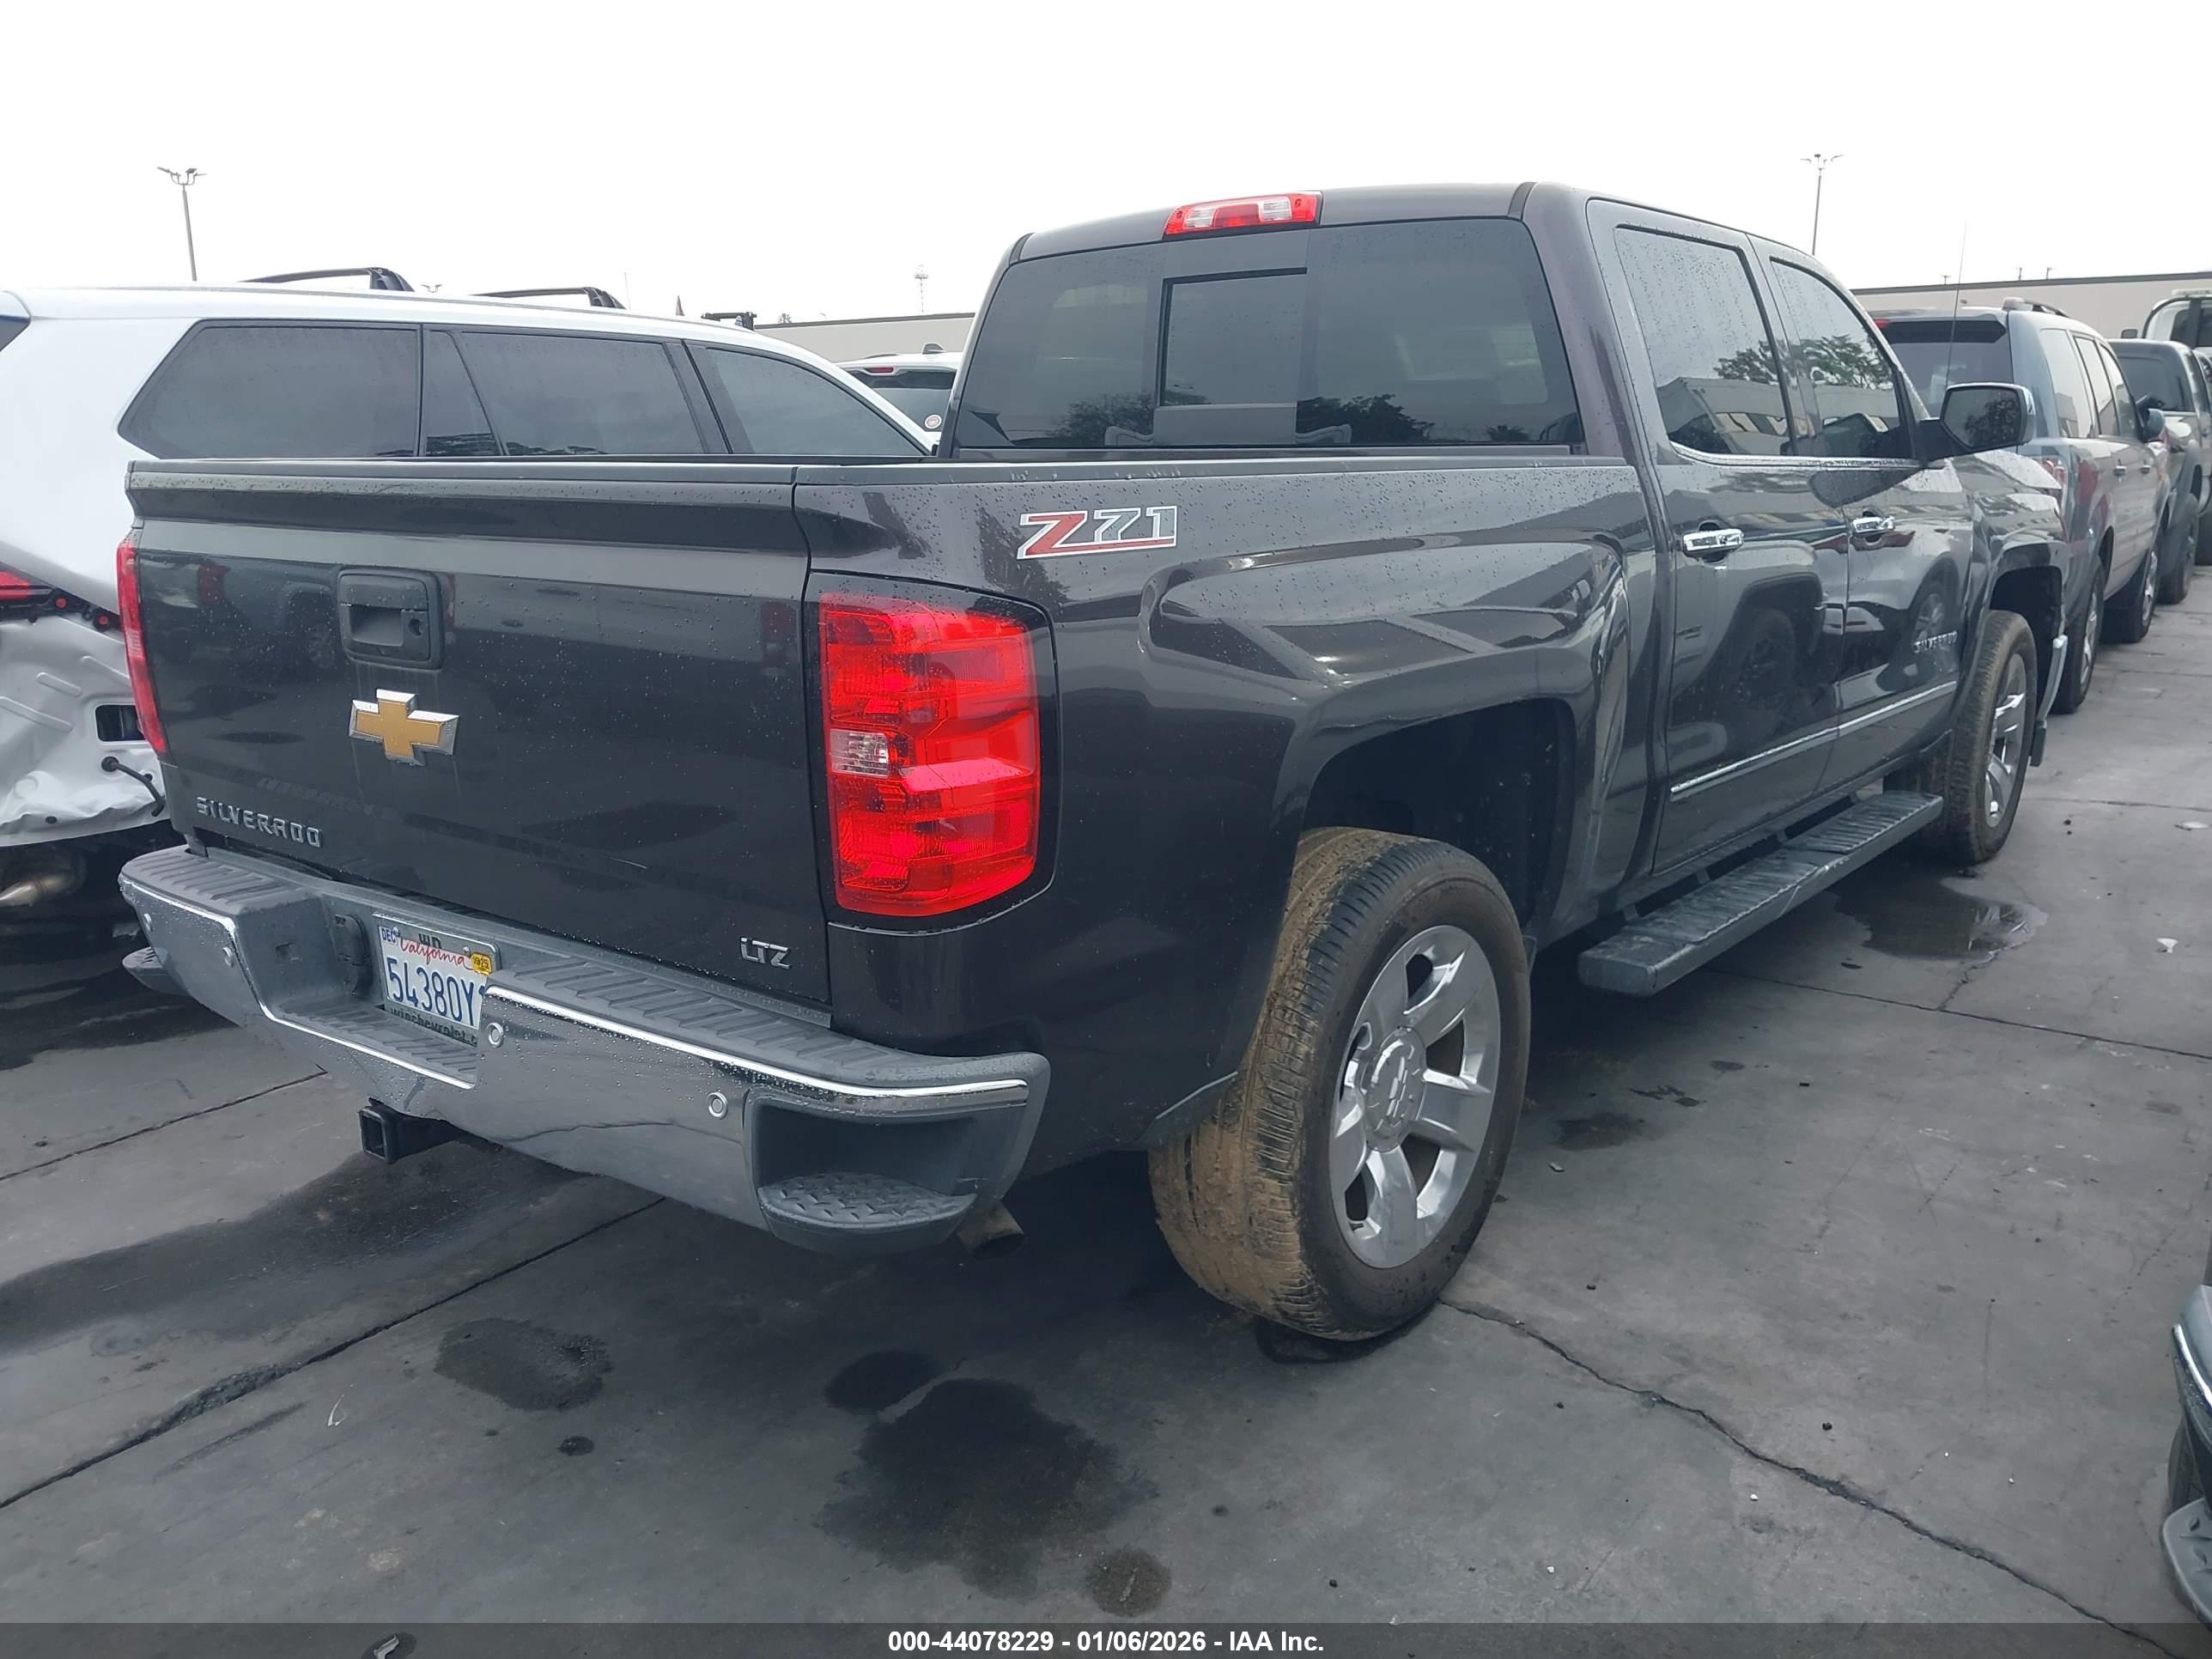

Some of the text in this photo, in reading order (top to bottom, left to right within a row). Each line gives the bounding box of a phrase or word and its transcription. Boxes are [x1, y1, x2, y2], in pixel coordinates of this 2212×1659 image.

[1017, 505, 1177, 559] Z71
[197, 796, 323, 848] SILVERADO
[381, 927, 397, 944] DEC
[399, 938, 474, 971] California
[740, 937, 790, 969] LTZ
[387, 957, 486, 1027] 54380Y
